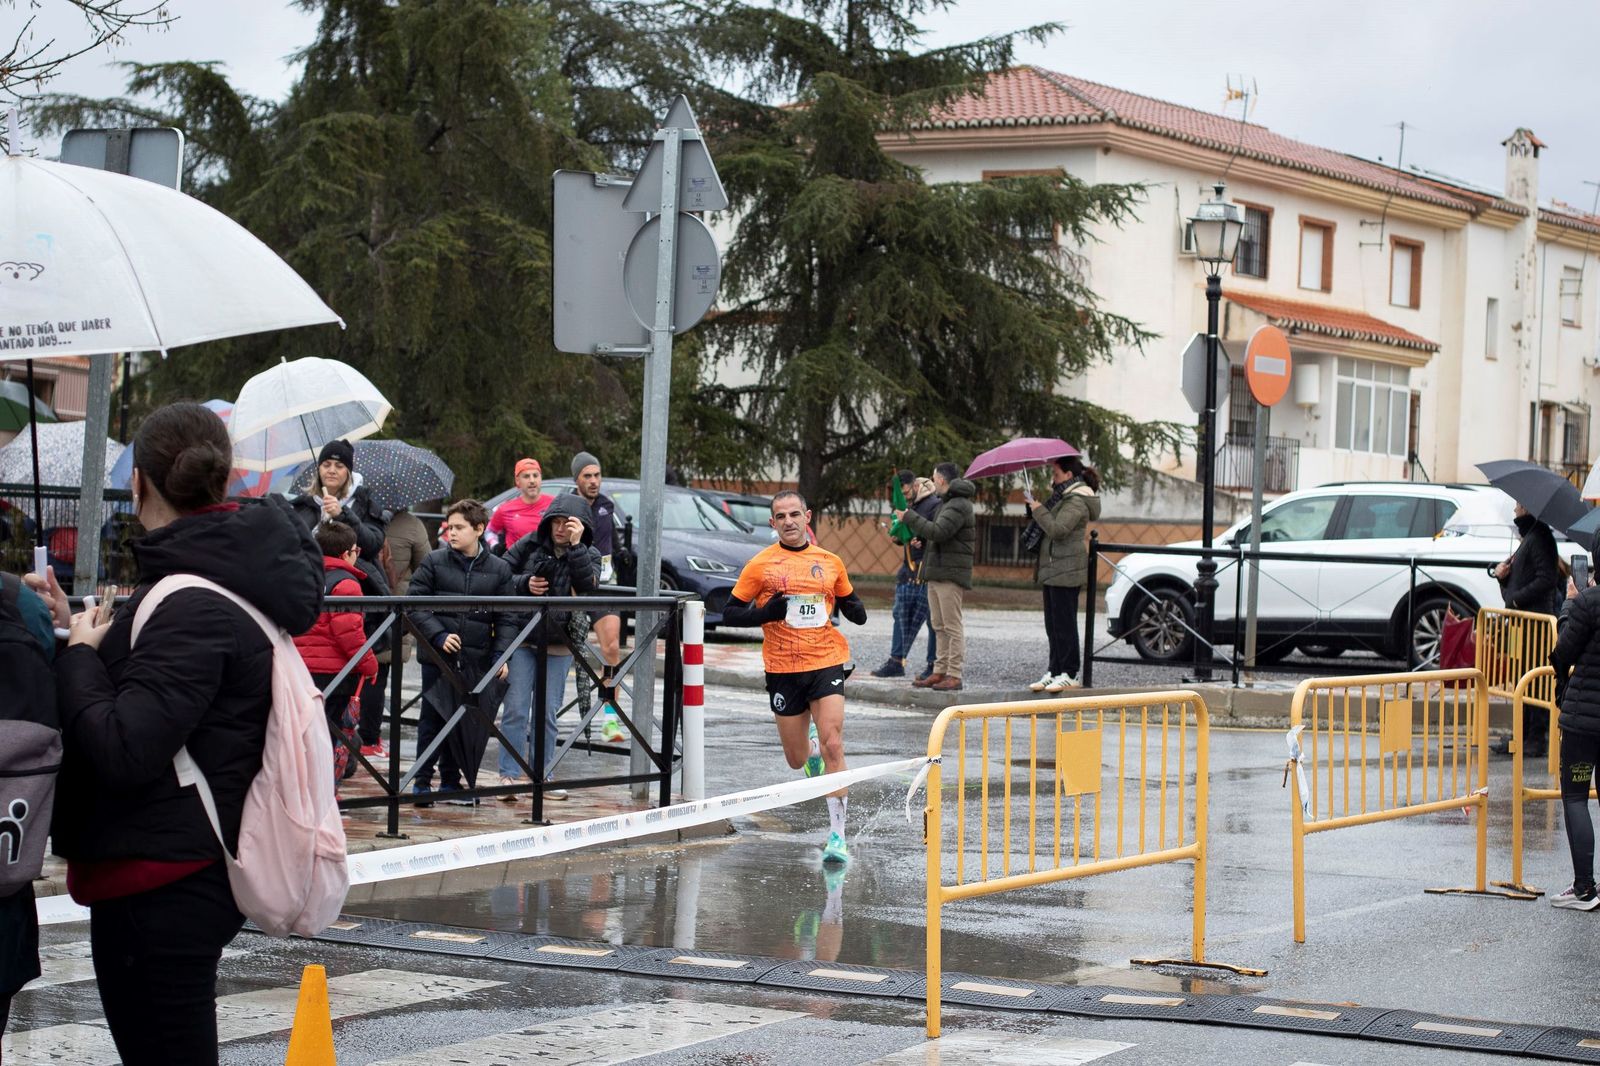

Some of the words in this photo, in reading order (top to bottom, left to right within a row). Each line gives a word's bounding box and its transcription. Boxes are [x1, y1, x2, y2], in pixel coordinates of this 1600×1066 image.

[8, 325, 22, 336] NO
[25, 321, 55, 336] TENÍA
[58, 321, 77, 333] QUE
[81, 318, 111, 331] HABER
[799, 604, 816, 615] 475
